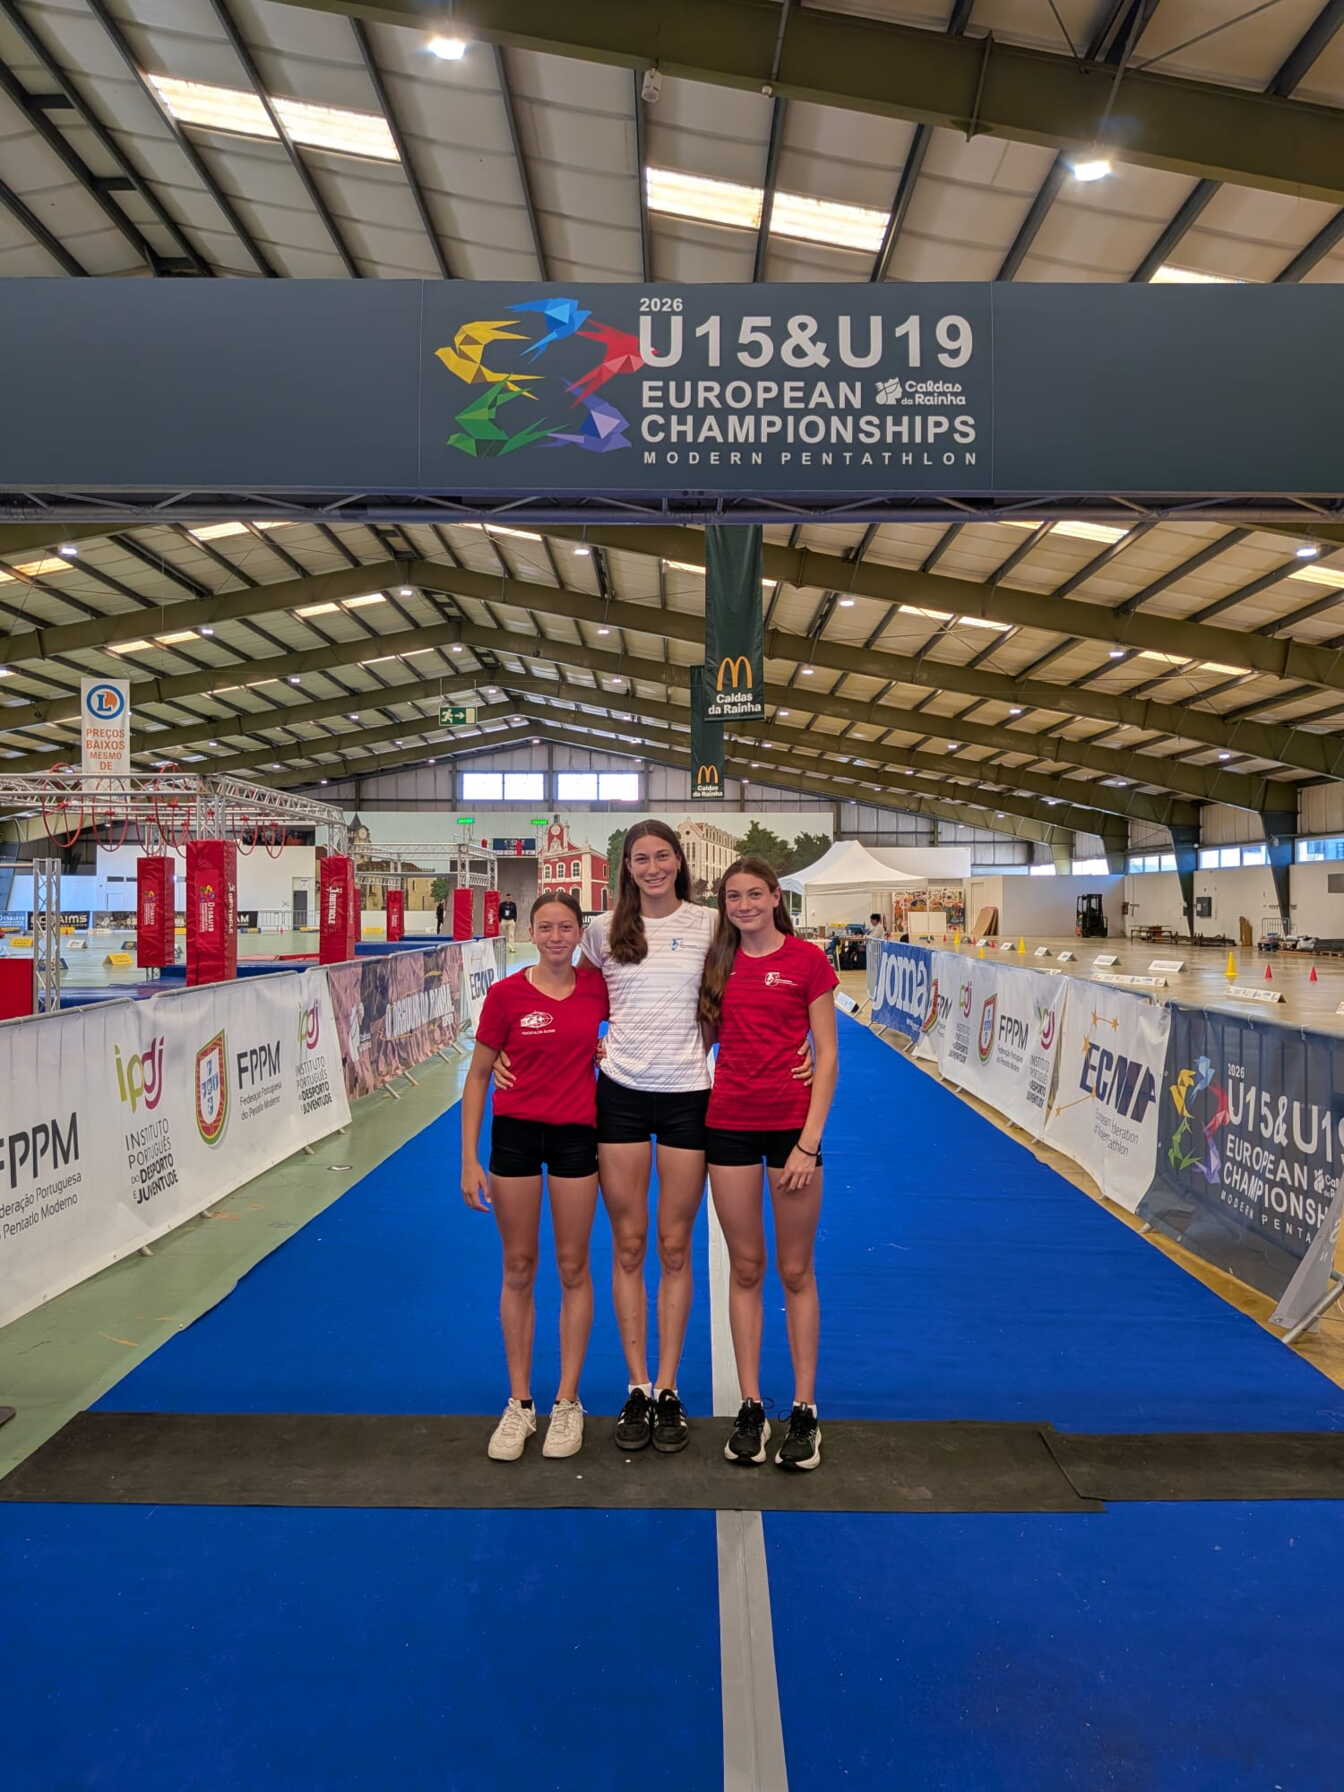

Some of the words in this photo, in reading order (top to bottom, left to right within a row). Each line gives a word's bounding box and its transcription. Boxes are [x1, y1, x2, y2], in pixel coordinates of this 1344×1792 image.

[639, 298, 684, 312] 2026
[639, 314, 974, 369] U15&U19
[642, 380, 862, 409] EUROPEAN
[904, 380, 963, 393] Caldas
[915, 393, 967, 406] Rainha
[640, 415, 977, 444] CHAMPIONSHIPS
[643, 452, 763, 465] MODERN
[781, 452, 977, 465] PENTATHLON
[708, 706, 721, 715] da
[723, 702, 762, 714] Rainha
[716, 692, 753, 704] Caldas
[86, 728, 125, 739] PREÇOS
[86, 740, 126, 750] BAIXOS
[90, 752, 122, 760] MESMO
[100, 761, 113, 771] DE
[998, 1015, 1029, 1050] FPPM
[236, 1040, 281, 1090] FPPM
[1228, 1063, 1245, 1079] 2026
[302, 1081, 330, 1101] DESPORTO
[303, 1093, 333, 1115] JUVENTUDE
[125, 1118, 170, 1151] INSTITUTO
[128, 1135, 172, 1169] PORTUGUÊS
[1226, 1134, 1309, 1191] EUROPEAN
[139, 1153, 175, 1184] DESPORTO
[36, 1172, 82, 1201] Portuguesa
[137, 1169, 178, 1204] JUVENTUDE
[3, 1211, 40, 1240] Pentatlo
[41, 1193, 78, 1220] Moderno
